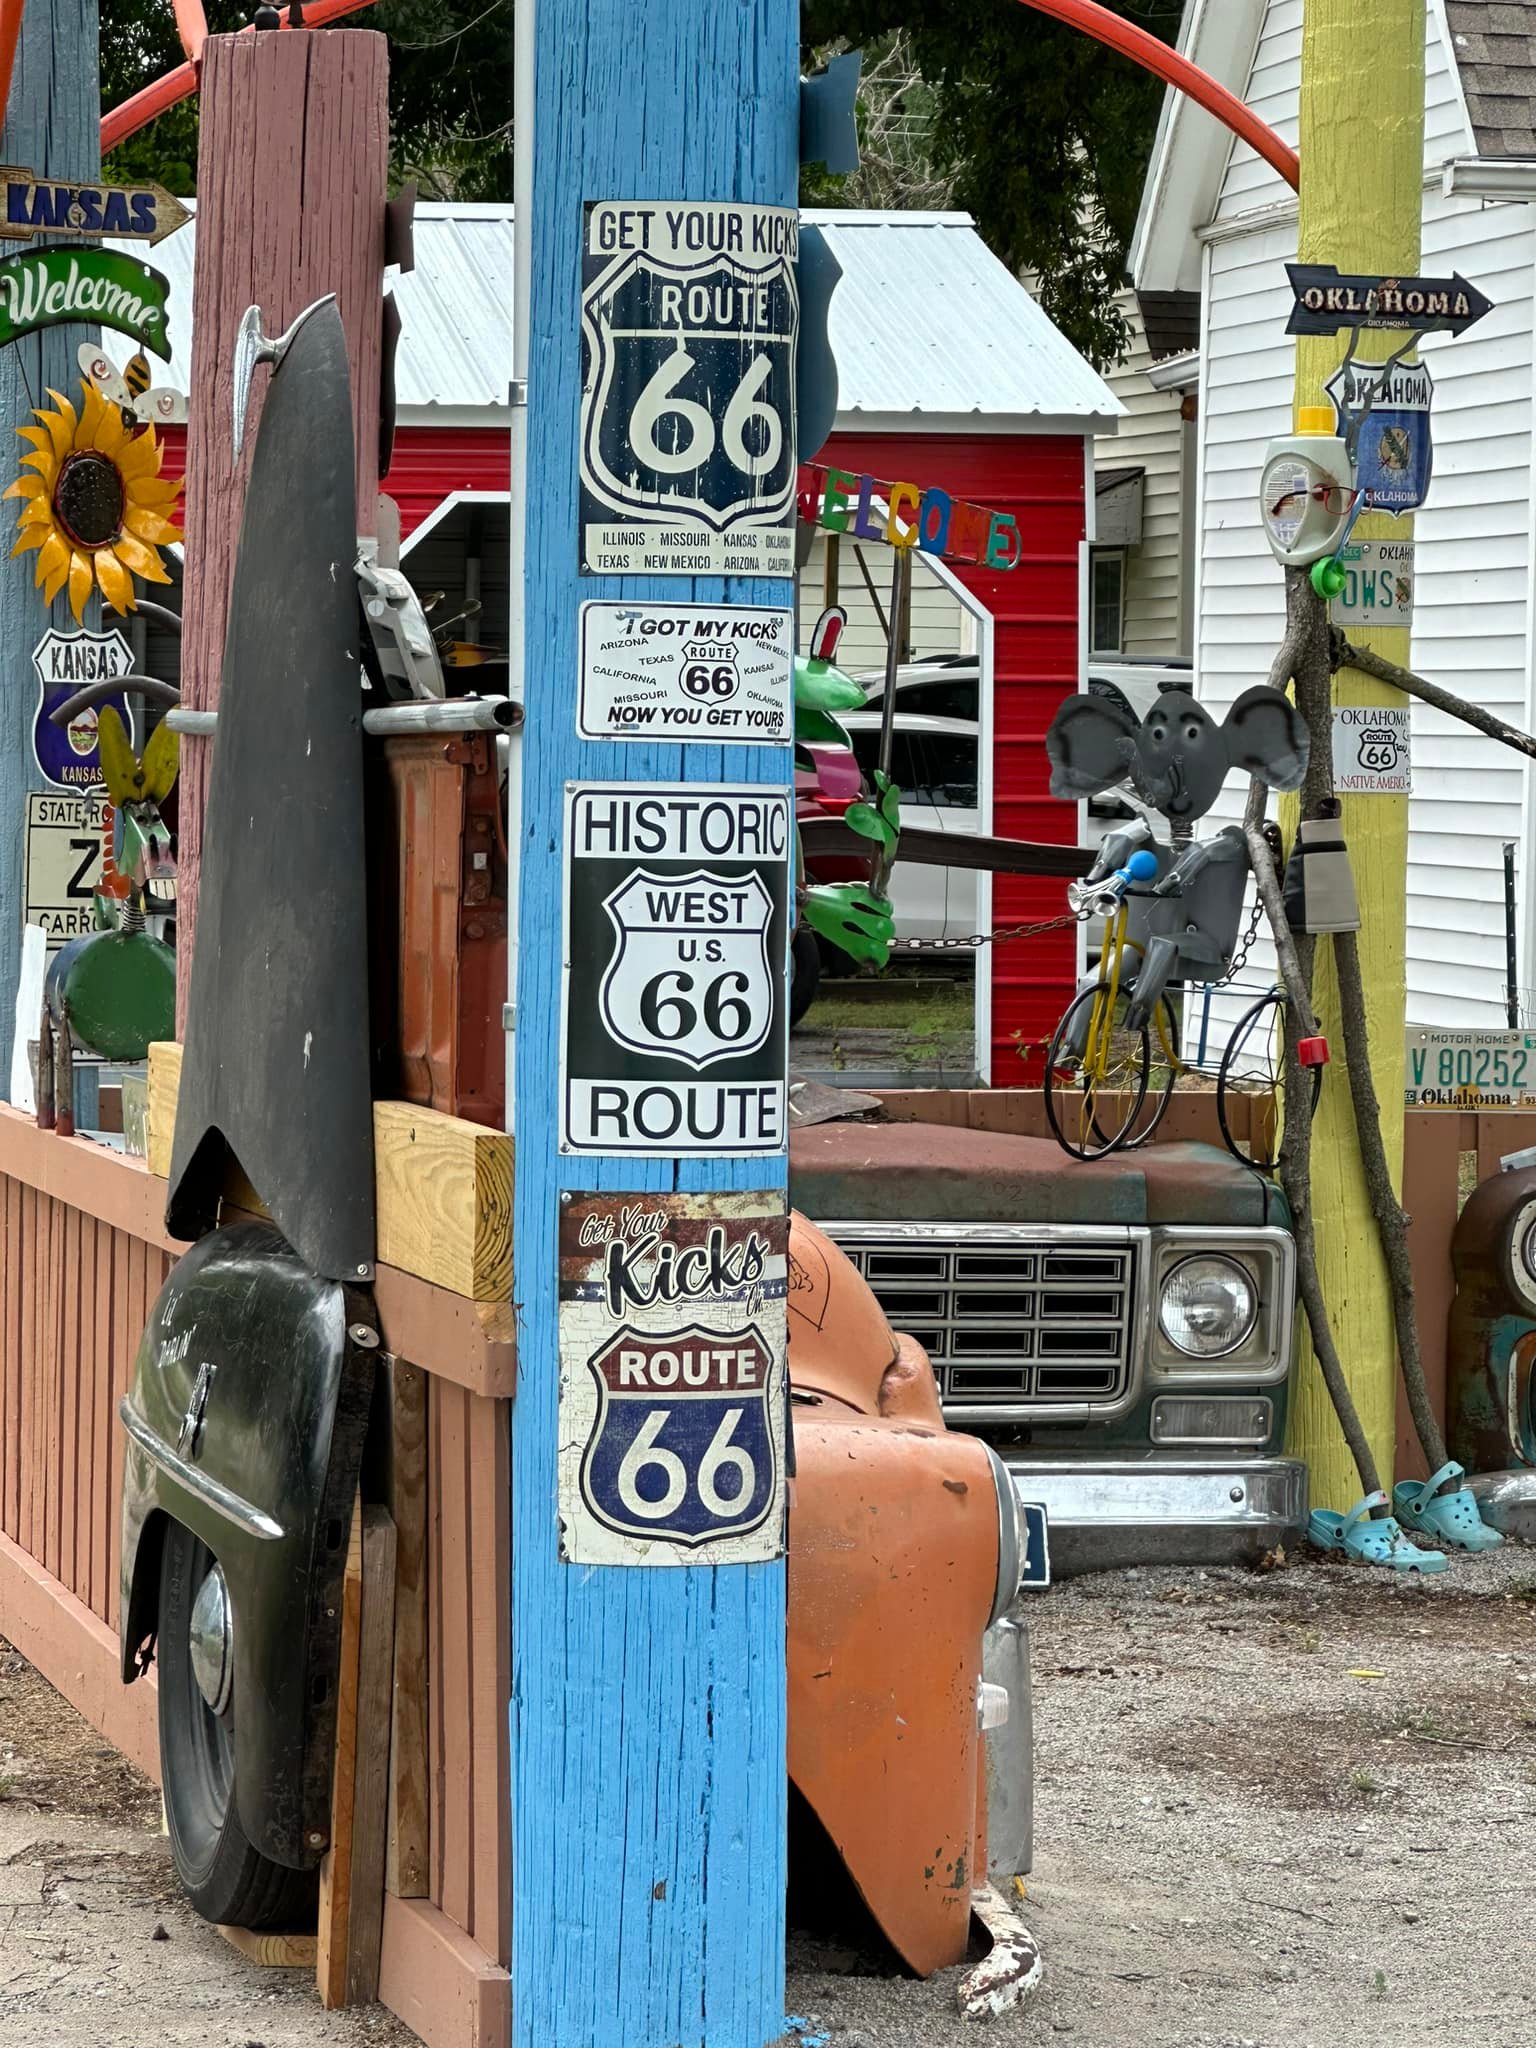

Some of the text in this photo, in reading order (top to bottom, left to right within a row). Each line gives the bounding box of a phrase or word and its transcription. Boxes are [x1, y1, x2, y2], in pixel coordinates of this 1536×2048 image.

[7, 182, 158, 234] KANSAS
[600, 210, 799, 258] GET YOUR KICKS
[0, 257, 161, 330] Welcome
[661, 285, 769, 327] ROUTE
[1303, 286, 1470, 316] OKLAHOMA
[628, 348, 783, 476] 66
[602, 531, 646, 547] ILLINOIS
[660, 531, 711, 548] MISSOURI
[723, 533, 758, 549] KANSAS
[597, 554, 630, 569] TEXAS
[644, 555, 669, 569] NEW
[671, 555, 711, 569] MEXICO
[723, 556, 760, 571] ARIZONA
[626, 618, 778, 640] I GOT MY KICKS
[600, 637, 649, 651] ARIZONA
[690, 646, 733, 659] ROUTE
[755, 639, 773, 652] NEW
[51, 645, 119, 681] KANSAS
[638, 654, 675, 667] TEXAS
[743, 662, 775, 676] KANSAS
[592, 664, 657, 686] CALIFORNIA
[685, 665, 735, 697] 66
[613, 690, 668, 705] MISSOURI
[746, 690, 784, 709] OKLAHOMA
[607, 706, 785, 728] NOW YOU GET YOURS
[1366, 746, 1392, 766] 66
[61, 765, 104, 783] KANSAS
[1340, 775, 1376, 790] NATIVE
[39, 801, 83, 823] STATE
[584, 800, 785, 856] HISTORIC
[66, 838, 100, 898] Z
[646, 891, 749, 924] WEST
[639, 970, 752, 1041] 66
[1431, 1034, 1510, 1045] MOTOR HOME
[1411, 1047, 1528, 1087] V 80252
[1421, 1087, 1511, 1105] Oklahoma
[590, 1085, 777, 1140] ROUTE
[580, 1203, 669, 1247] Get Your
[605, 1224, 771, 1319] Kicks
[619, 1349, 757, 1386] ROUTE
[617, 1408, 756, 1520] 66
